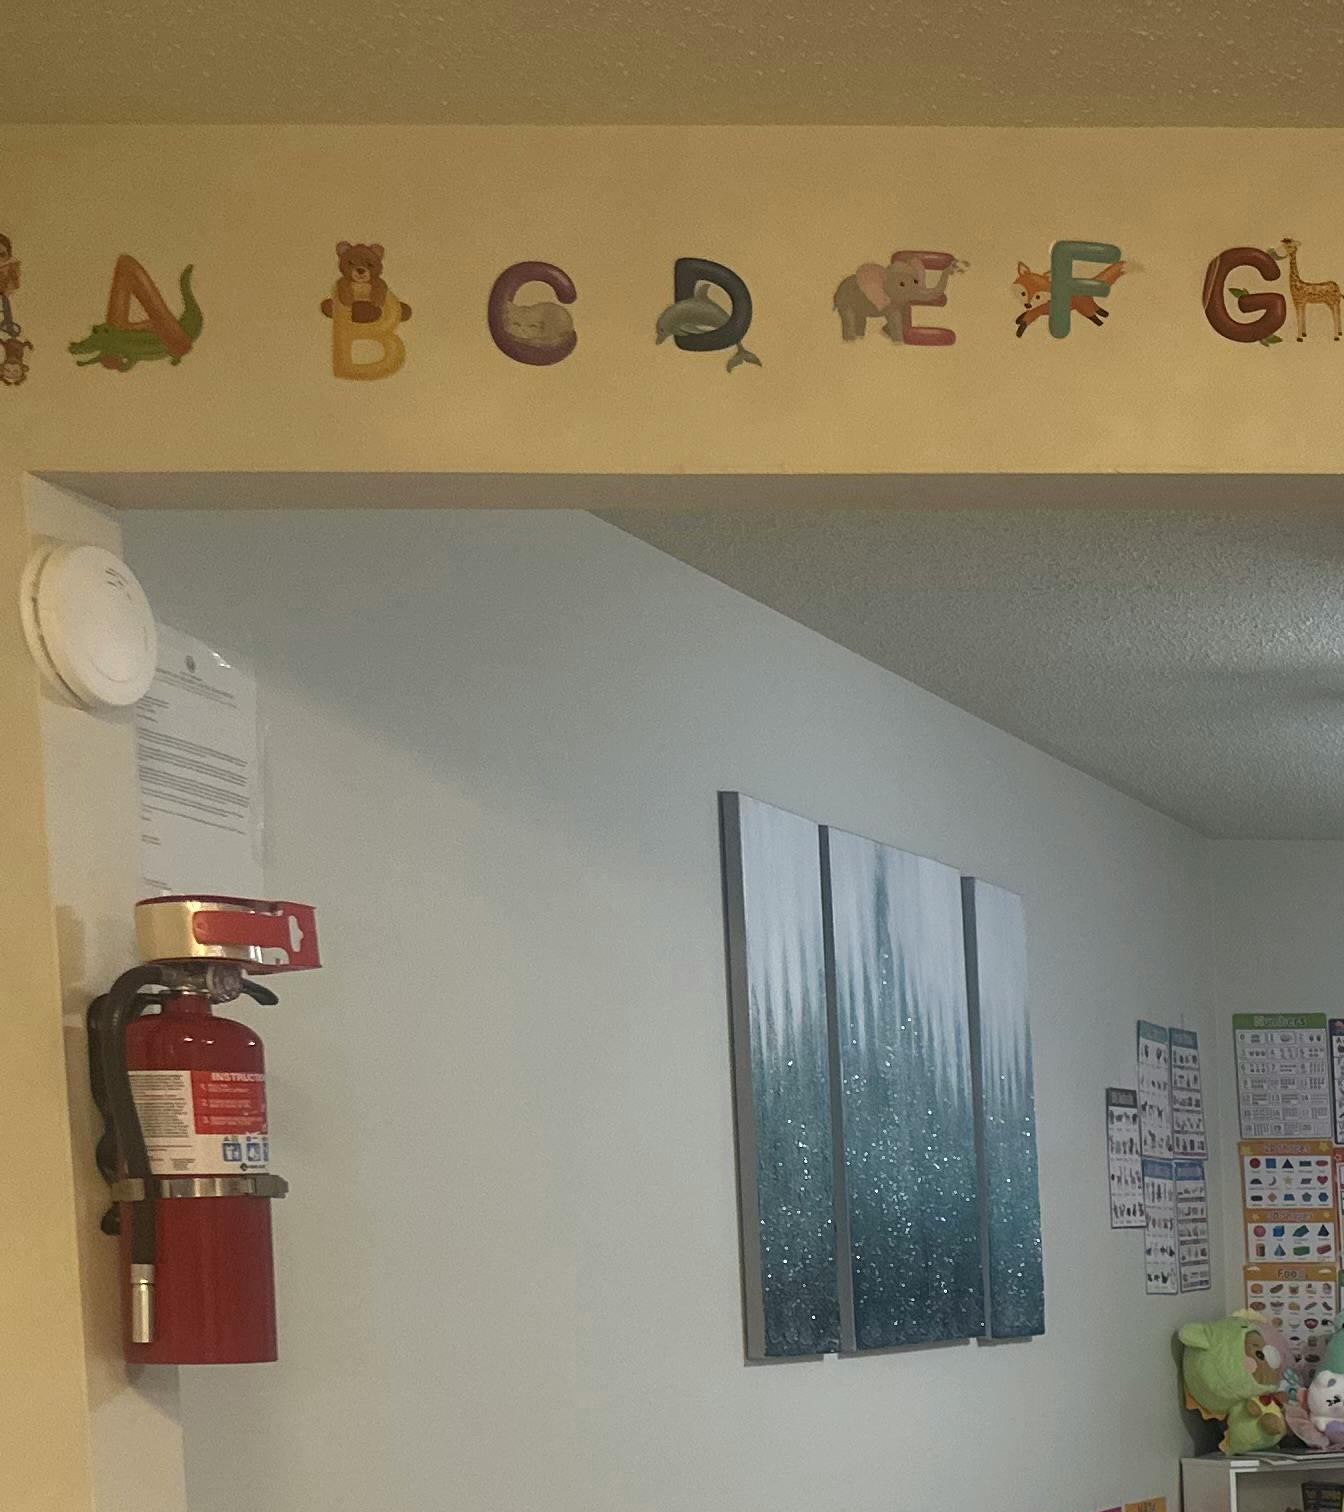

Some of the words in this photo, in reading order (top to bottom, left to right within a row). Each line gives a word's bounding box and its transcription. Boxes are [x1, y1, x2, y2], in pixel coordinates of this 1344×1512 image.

[104, 253, 193, 357] A
[331, 284, 407, 381] B
[487, 260, 578, 366] C
[674, 257, 753, 352] D
[891, 249, 957, 347] E
[1047, 240, 1122, 340] F
[1202, 246, 1287, 343] G
